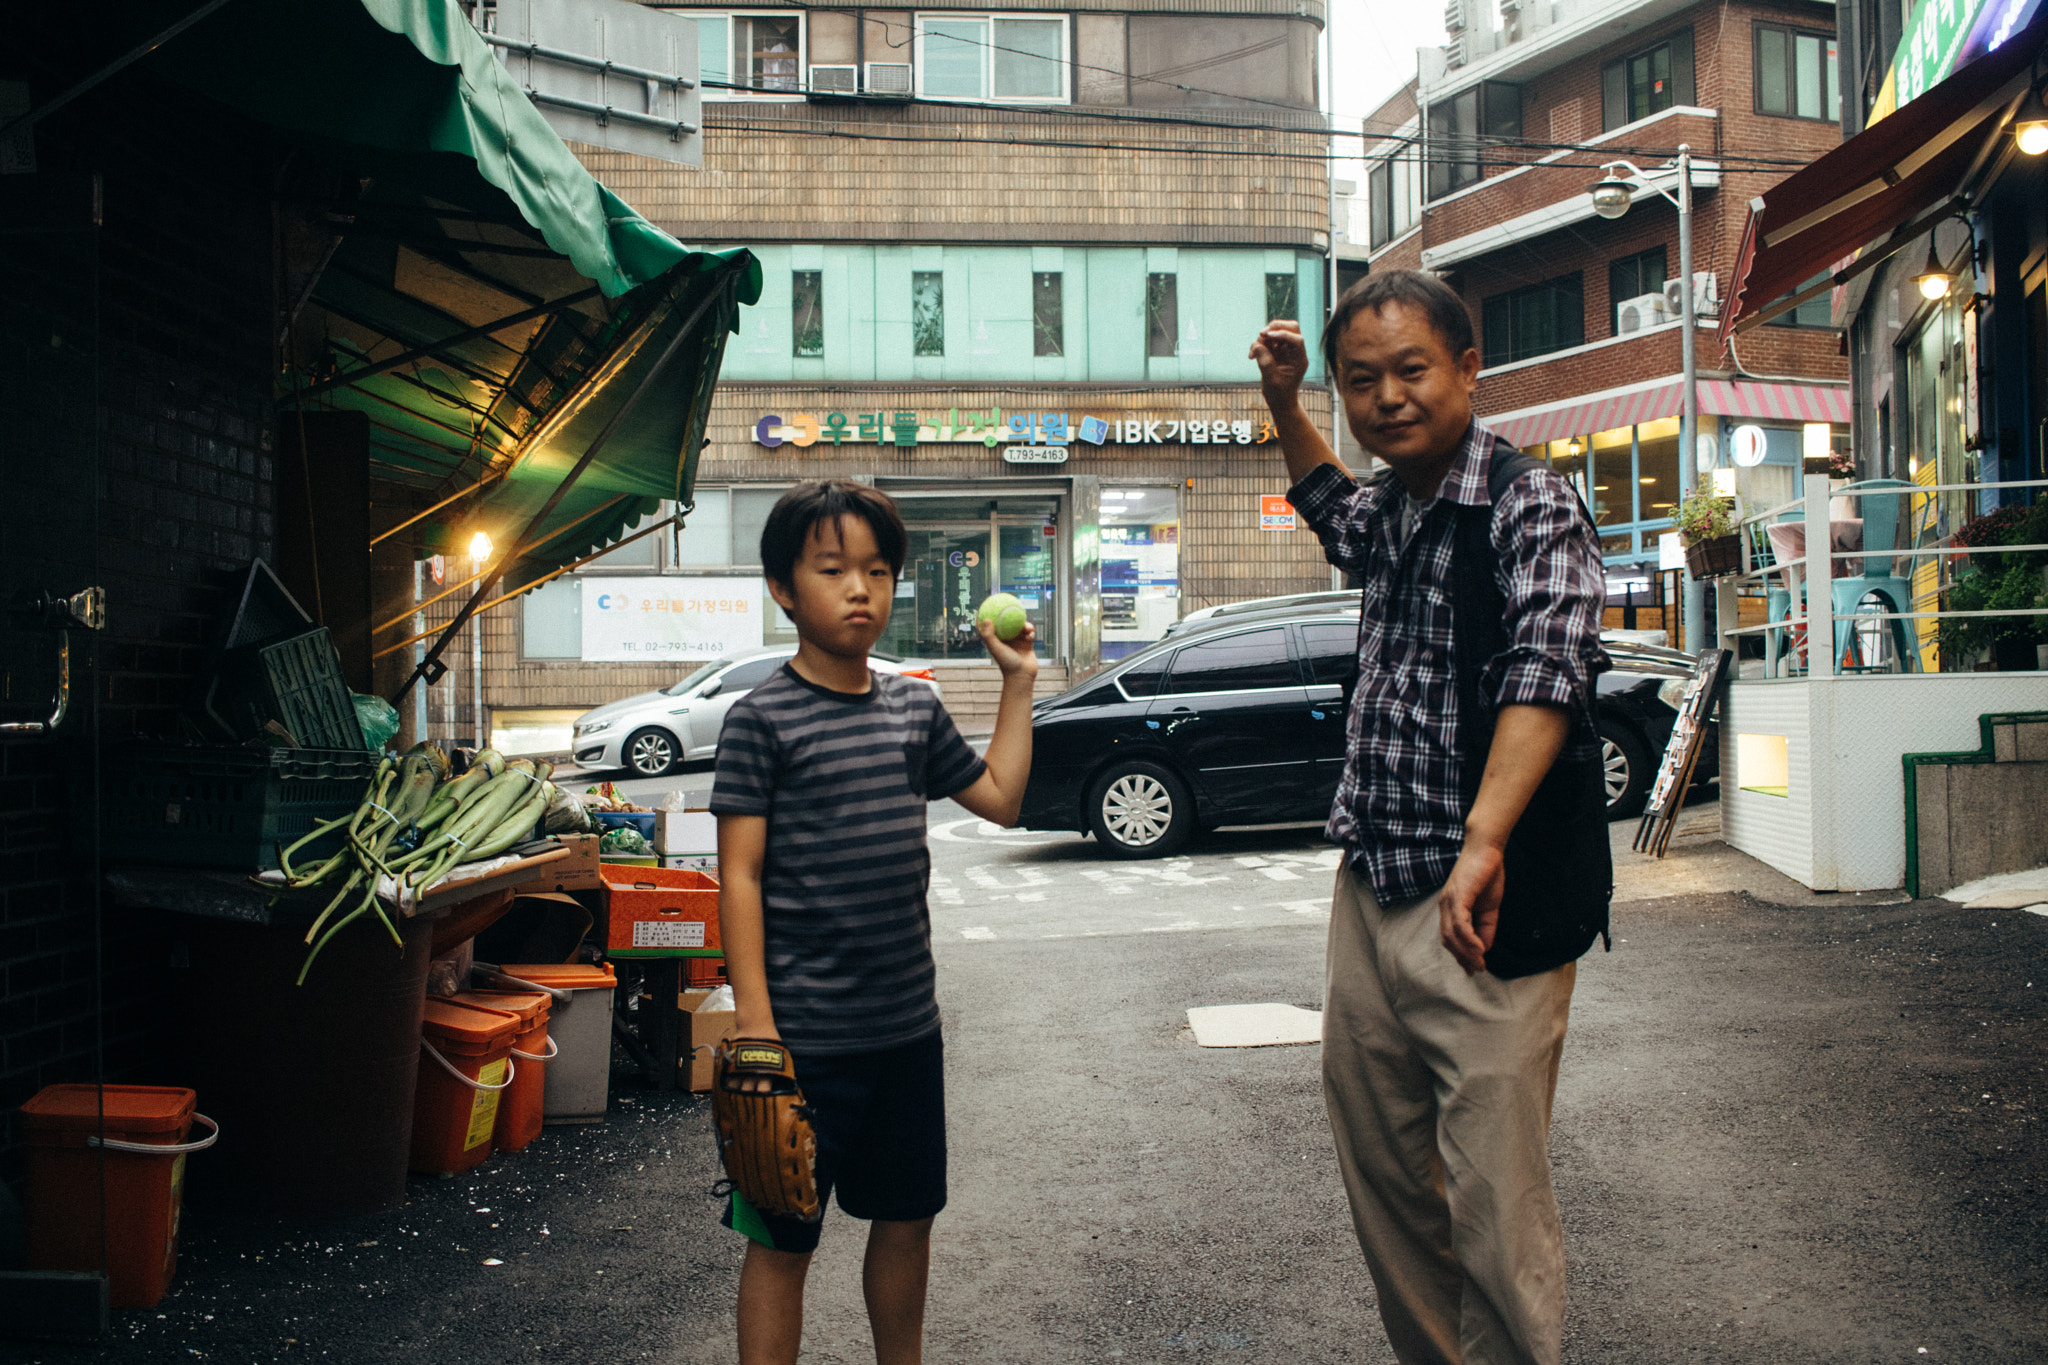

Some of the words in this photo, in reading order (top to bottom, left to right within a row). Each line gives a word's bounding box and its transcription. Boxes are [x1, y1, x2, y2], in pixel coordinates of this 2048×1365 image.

[821, 407, 1069, 447] 우리들가정의원
[1115, 419, 1252, 445] IBK기업은행
[1008, 449, 1064, 461] T.793-4163
[1263, 516, 1293, 524] SECOM
[640, 599, 749, 614] 우리들가정의원
[645, 642, 724, 651] 02-793-4163
